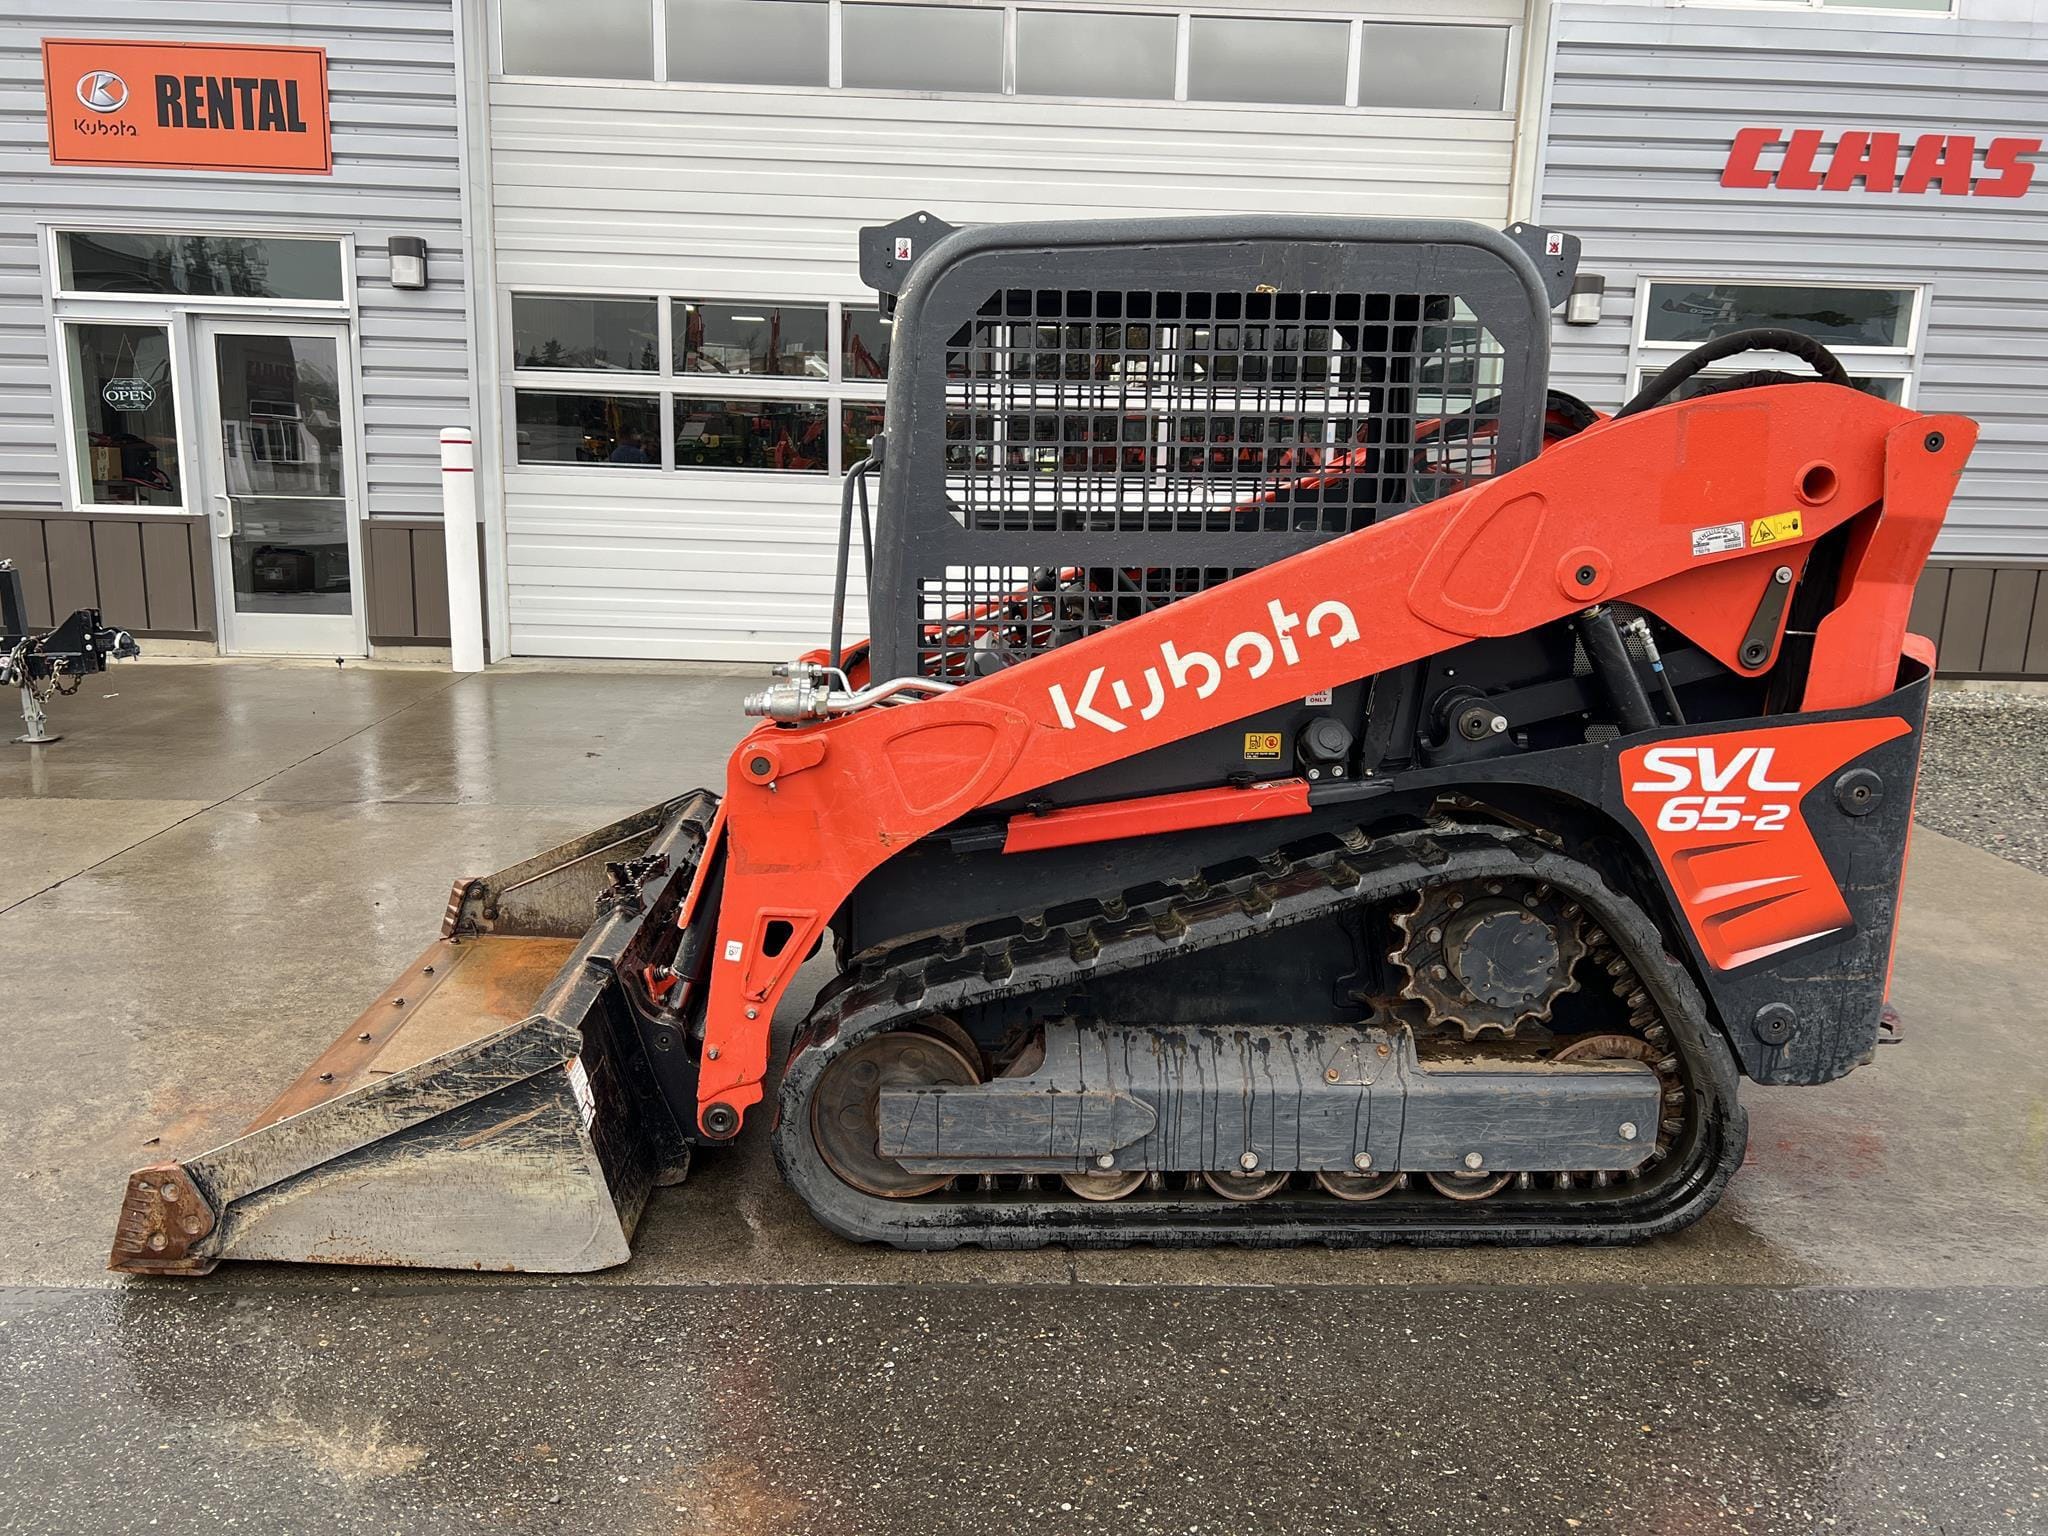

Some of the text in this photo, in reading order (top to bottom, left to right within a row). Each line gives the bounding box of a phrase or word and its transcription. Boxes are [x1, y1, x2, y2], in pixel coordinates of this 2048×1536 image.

[154, 74, 307, 133] RENTAL
[74, 118, 137, 136] Kubota
[1719, 127, 2043, 198] CLAAS
[105, 390, 152, 401] OPEN
[1048, 598, 1361, 733] Kubota
[1631, 747, 1801, 792] SVL
[1657, 796, 1791, 832] 65-2
